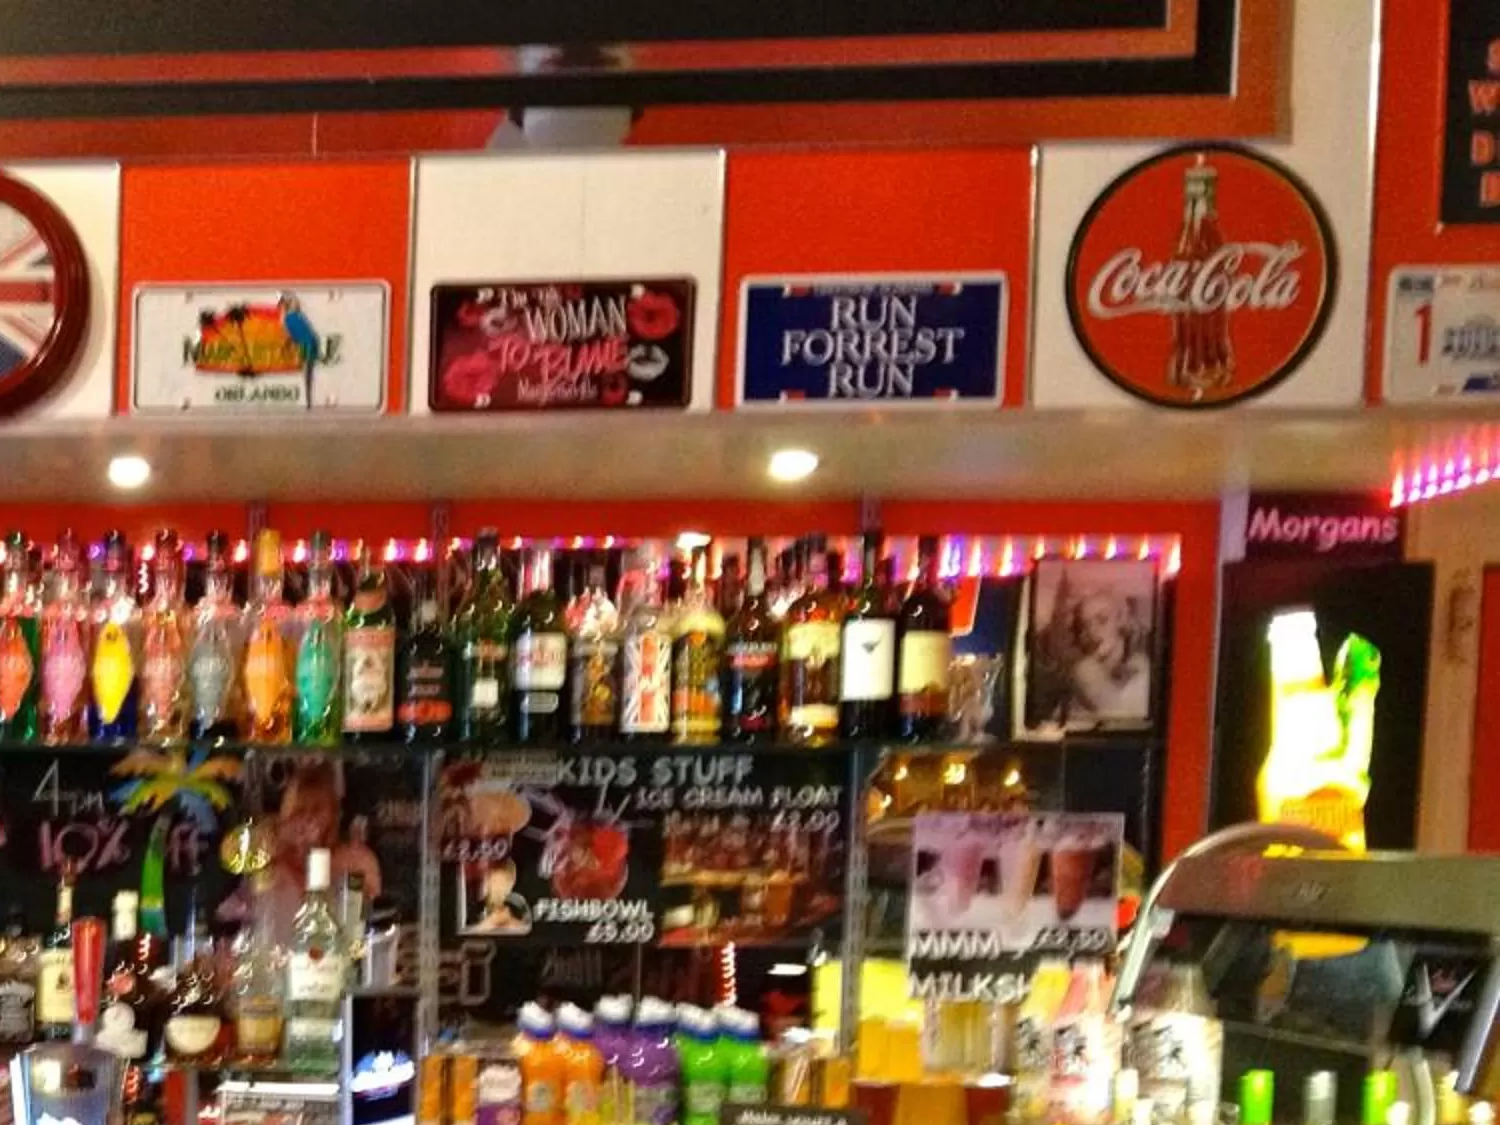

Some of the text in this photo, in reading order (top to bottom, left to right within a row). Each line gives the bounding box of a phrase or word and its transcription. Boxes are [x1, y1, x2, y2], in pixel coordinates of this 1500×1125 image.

[524, 295, 628, 343] WOMAN
[829, 295, 917, 330] RUN
[780, 326, 965, 365] FORREST
[215, 384, 300, 401] ORLANDO
[827, 361, 915, 399] RUN
[1247, 509, 1400, 552] Morgans
[557, 755, 754, 787] KIDS STUFF
[682, 785, 764, 810] CREAM
[769, 784, 843, 809] FLOAT
[533, 898, 654, 923] FISHBOWL
[909, 971, 1035, 1004] MILKSH
